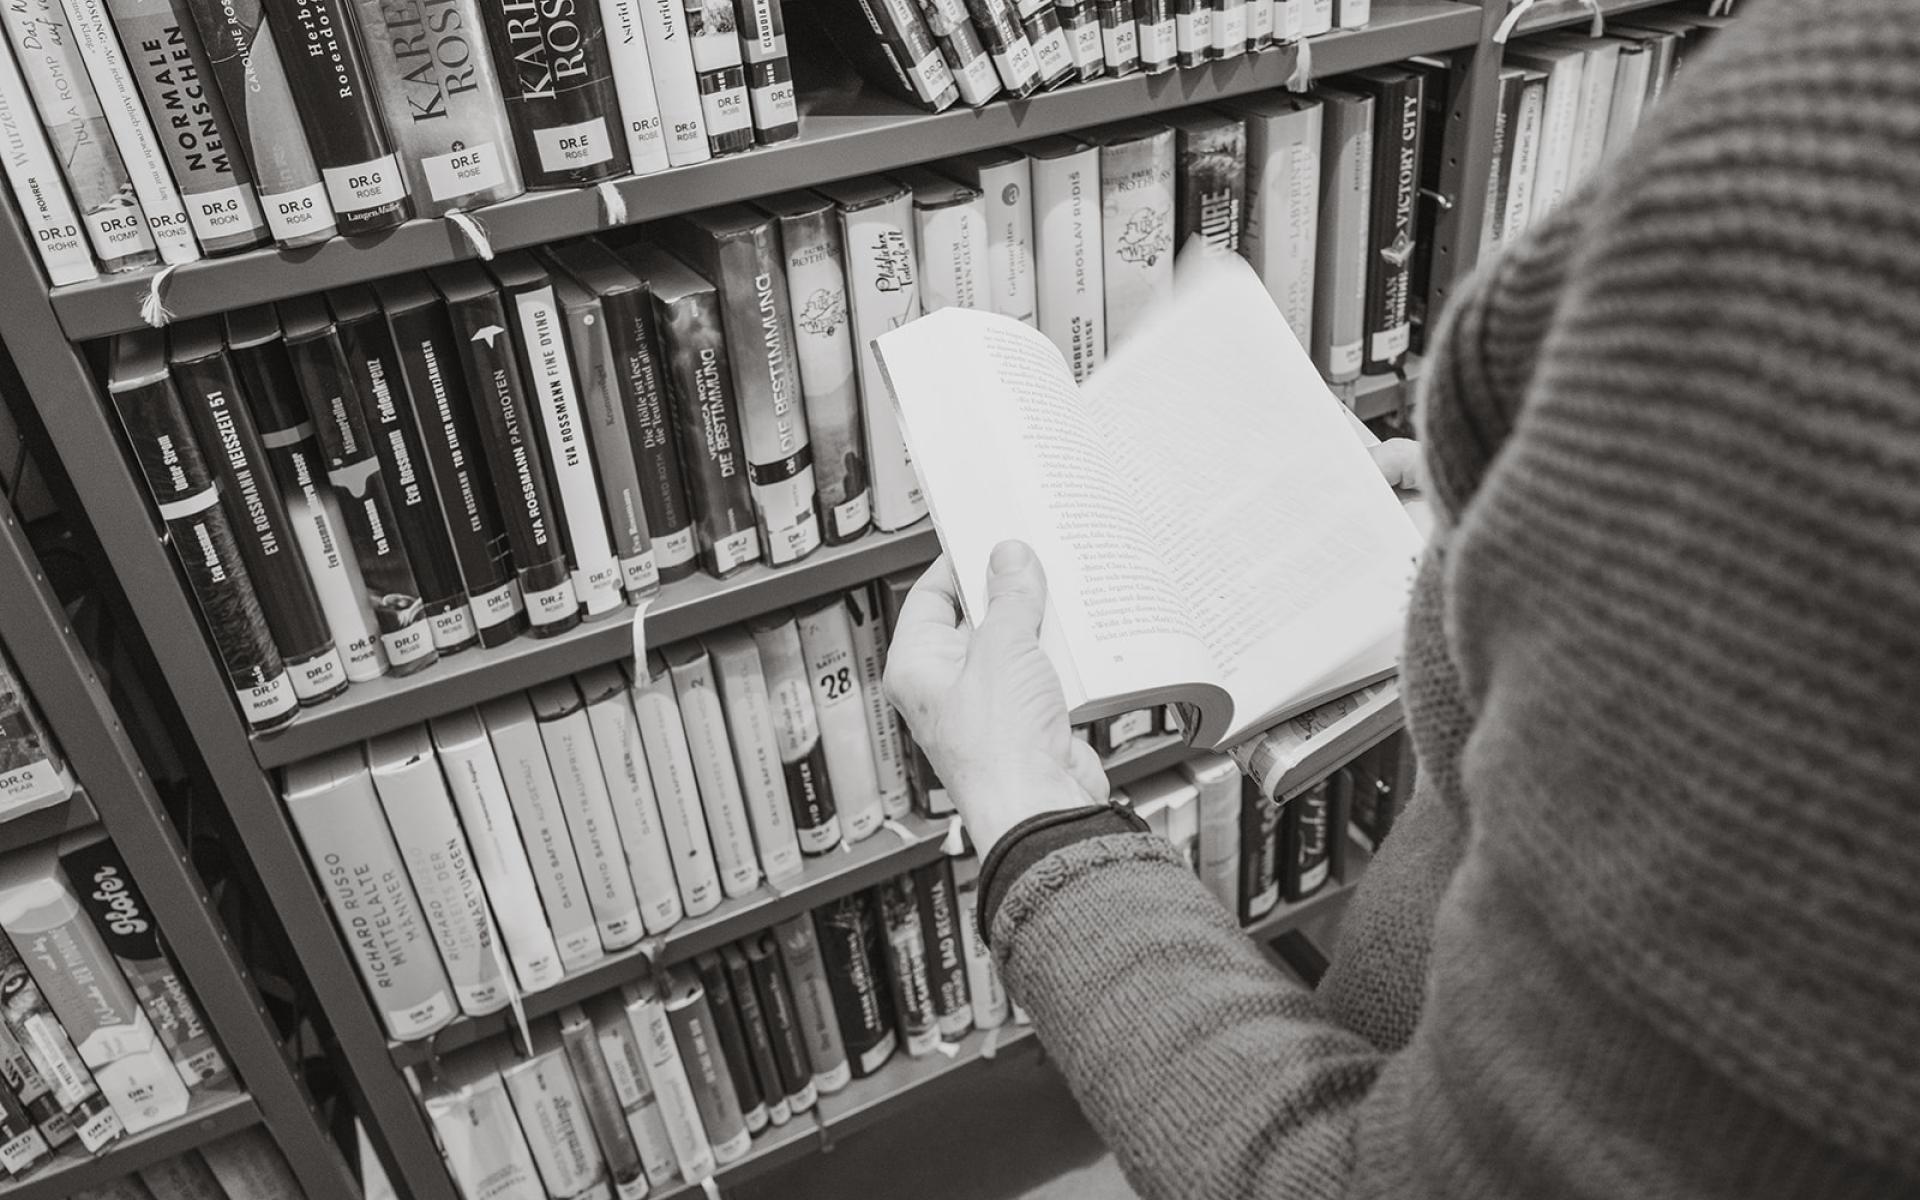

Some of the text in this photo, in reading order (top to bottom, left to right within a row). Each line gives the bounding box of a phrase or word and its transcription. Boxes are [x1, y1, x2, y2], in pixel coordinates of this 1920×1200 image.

[22, 21, 42, 50] Das
[758, 10, 772, 48] CLAUDIA
[232, 29, 261, 93] CAROLINE
[313, 0, 352, 98] Rosendor
[45, 56, 93, 146] JULIA ROMP
[142, 37, 206, 172] NORMALE
[163, 26, 231, 173] MENSCHEN
[718, 96, 741, 108] DR.E
[632, 117, 659, 133] DR.G
[675, 122, 696, 133] DR.G
[677, 131, 698, 141] ROSE
[451, 153, 480, 169] DR.E
[559, 136, 588, 151] DR.E
[565, 147, 588, 159] ROSE
[457, 166, 481, 180] ROSE
[1396, 94, 1418, 229] VICTORY CITY
[28, 176, 49, 215] ROHRER
[349, 173, 382, 189] DR.G
[356, 187, 382, 199] ROSE
[202, 199, 238, 216] DR.G
[209, 215, 239, 225] ROON
[279, 198, 313, 214] DR.G
[286, 213, 312, 225] ROSA
[38, 225, 77, 241] DR.D
[100, 215, 138, 233] DR.G
[109, 230, 138, 243] ROMP
[157, 228, 187, 239] RONS
[47, 242, 78, 251] ROHR
[1073, 222, 1086, 295] JAROSLAV
[755, 272, 790, 416] BESTIMMUNG
[1071, 316, 1082, 388] TERBERGS
[534, 310, 579, 467] EVA ROSSMANN FINE DYING
[629, 356, 656, 449] Die Hölle ist leer
[649, 394, 664, 429] Teufel
[366, 357, 421, 506] Eva Rossmann Fadenkreuz
[655, 429, 666, 445] die
[777, 418, 794, 454] DIE
[157, 434, 178, 465] Strom
[493, 369, 548, 546] EVA ROSSMANN PATRIOTEN
[717, 452, 735, 478] DIE
[206, 390, 279, 556] EVA ROSSMANN HEISSZEIT 51
[457, 470, 479, 518] ROSSMANN
[471, 516, 482, 532] EVA
[210, 564, 226, 583] Eva
[437, 613, 462, 628] DR.D
[394, 633, 420, 648] DR.D
[306, 662, 333, 678] DR.D
[820, 665, 852, 700] 28
[253, 696, 279, 708] ROSS
[541, 827, 560, 869] SAFIER
[585, 817, 604, 859] SAFIER
[430, 851, 449, 882] DER
[599, 861, 615, 899] DAVID
[92, 866, 148, 935] Hofer
[383, 870, 421, 942] MÄNNER
[446, 836, 490, 949] ERWARTUNGEN
[555, 872, 572, 910] DAVID
[325, 853, 393, 989] RICHARD RUSSO
[354, 862, 407, 968] MITTELALTE
[429, 901, 461, 961] RICHARD
[931, 880, 958, 969] BAD REGINA
